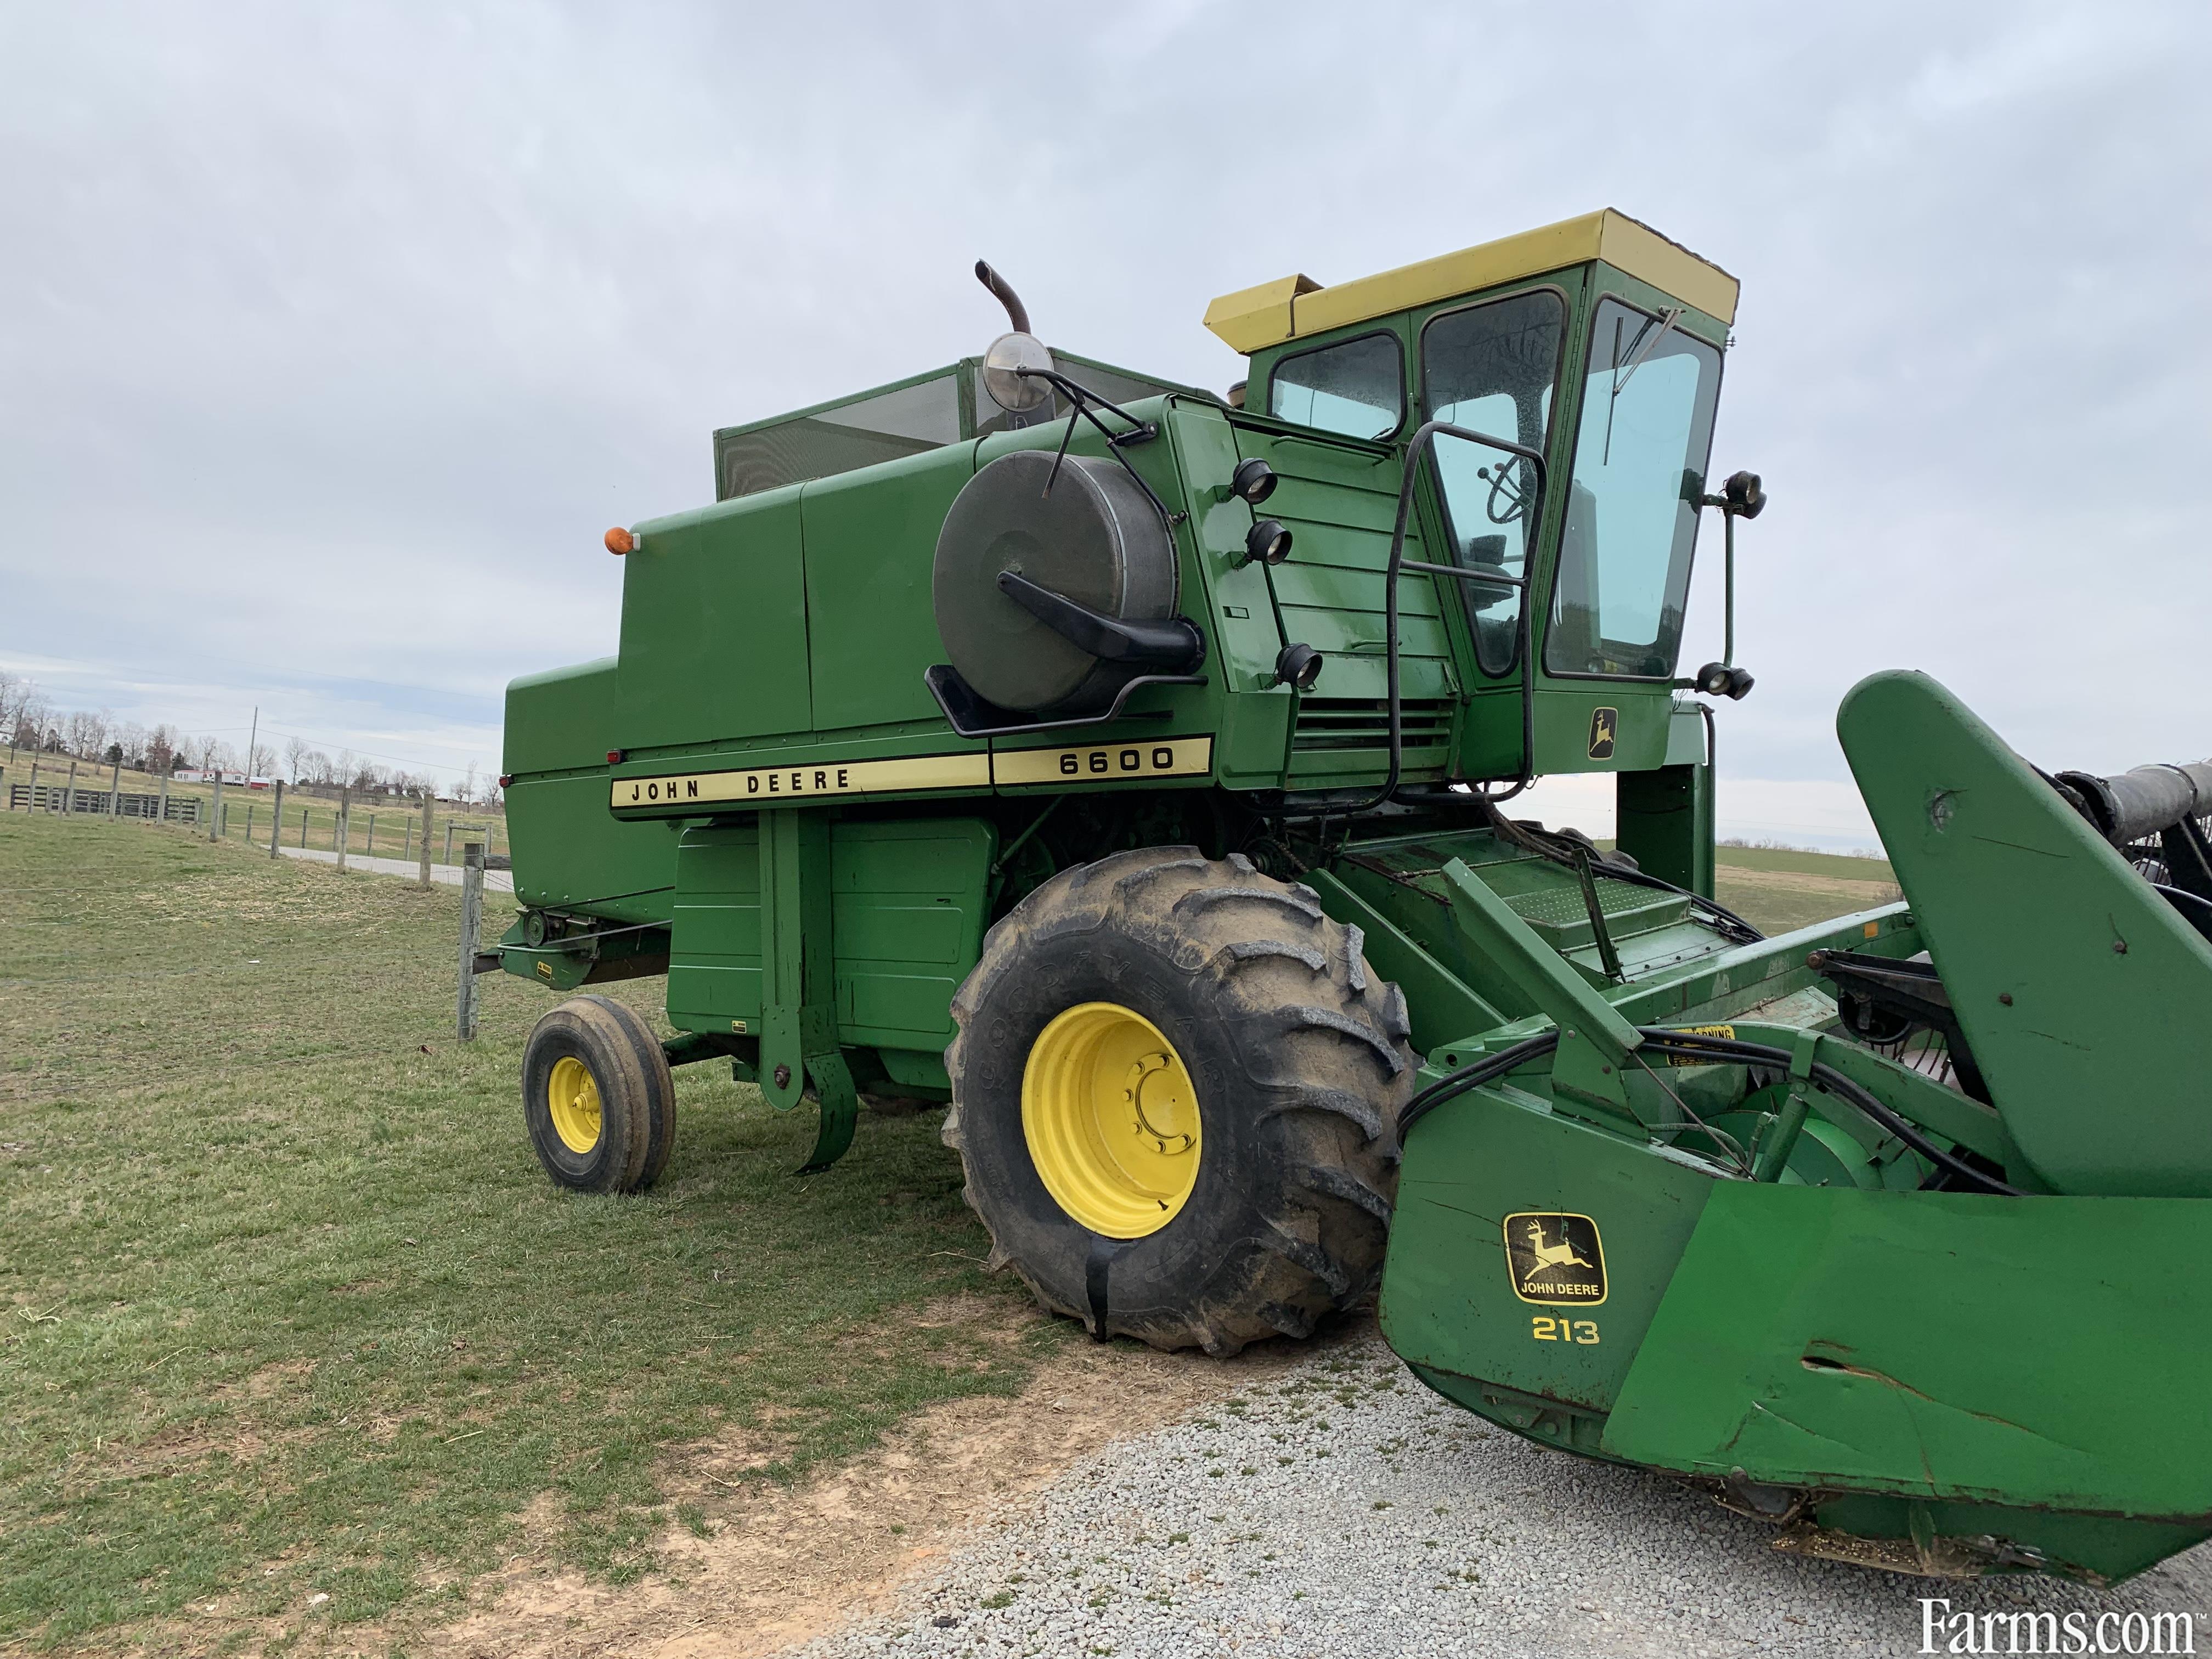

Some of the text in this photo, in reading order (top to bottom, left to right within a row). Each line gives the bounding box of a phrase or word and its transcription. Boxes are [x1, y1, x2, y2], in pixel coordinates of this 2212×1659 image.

[1060, 747, 1173, 775] 6600
[632, 769, 849, 801] JOHN DEERE
[1521, 1282, 1600, 1295] JOHN DEERE
[1532, 1317, 1600, 1345] 213
